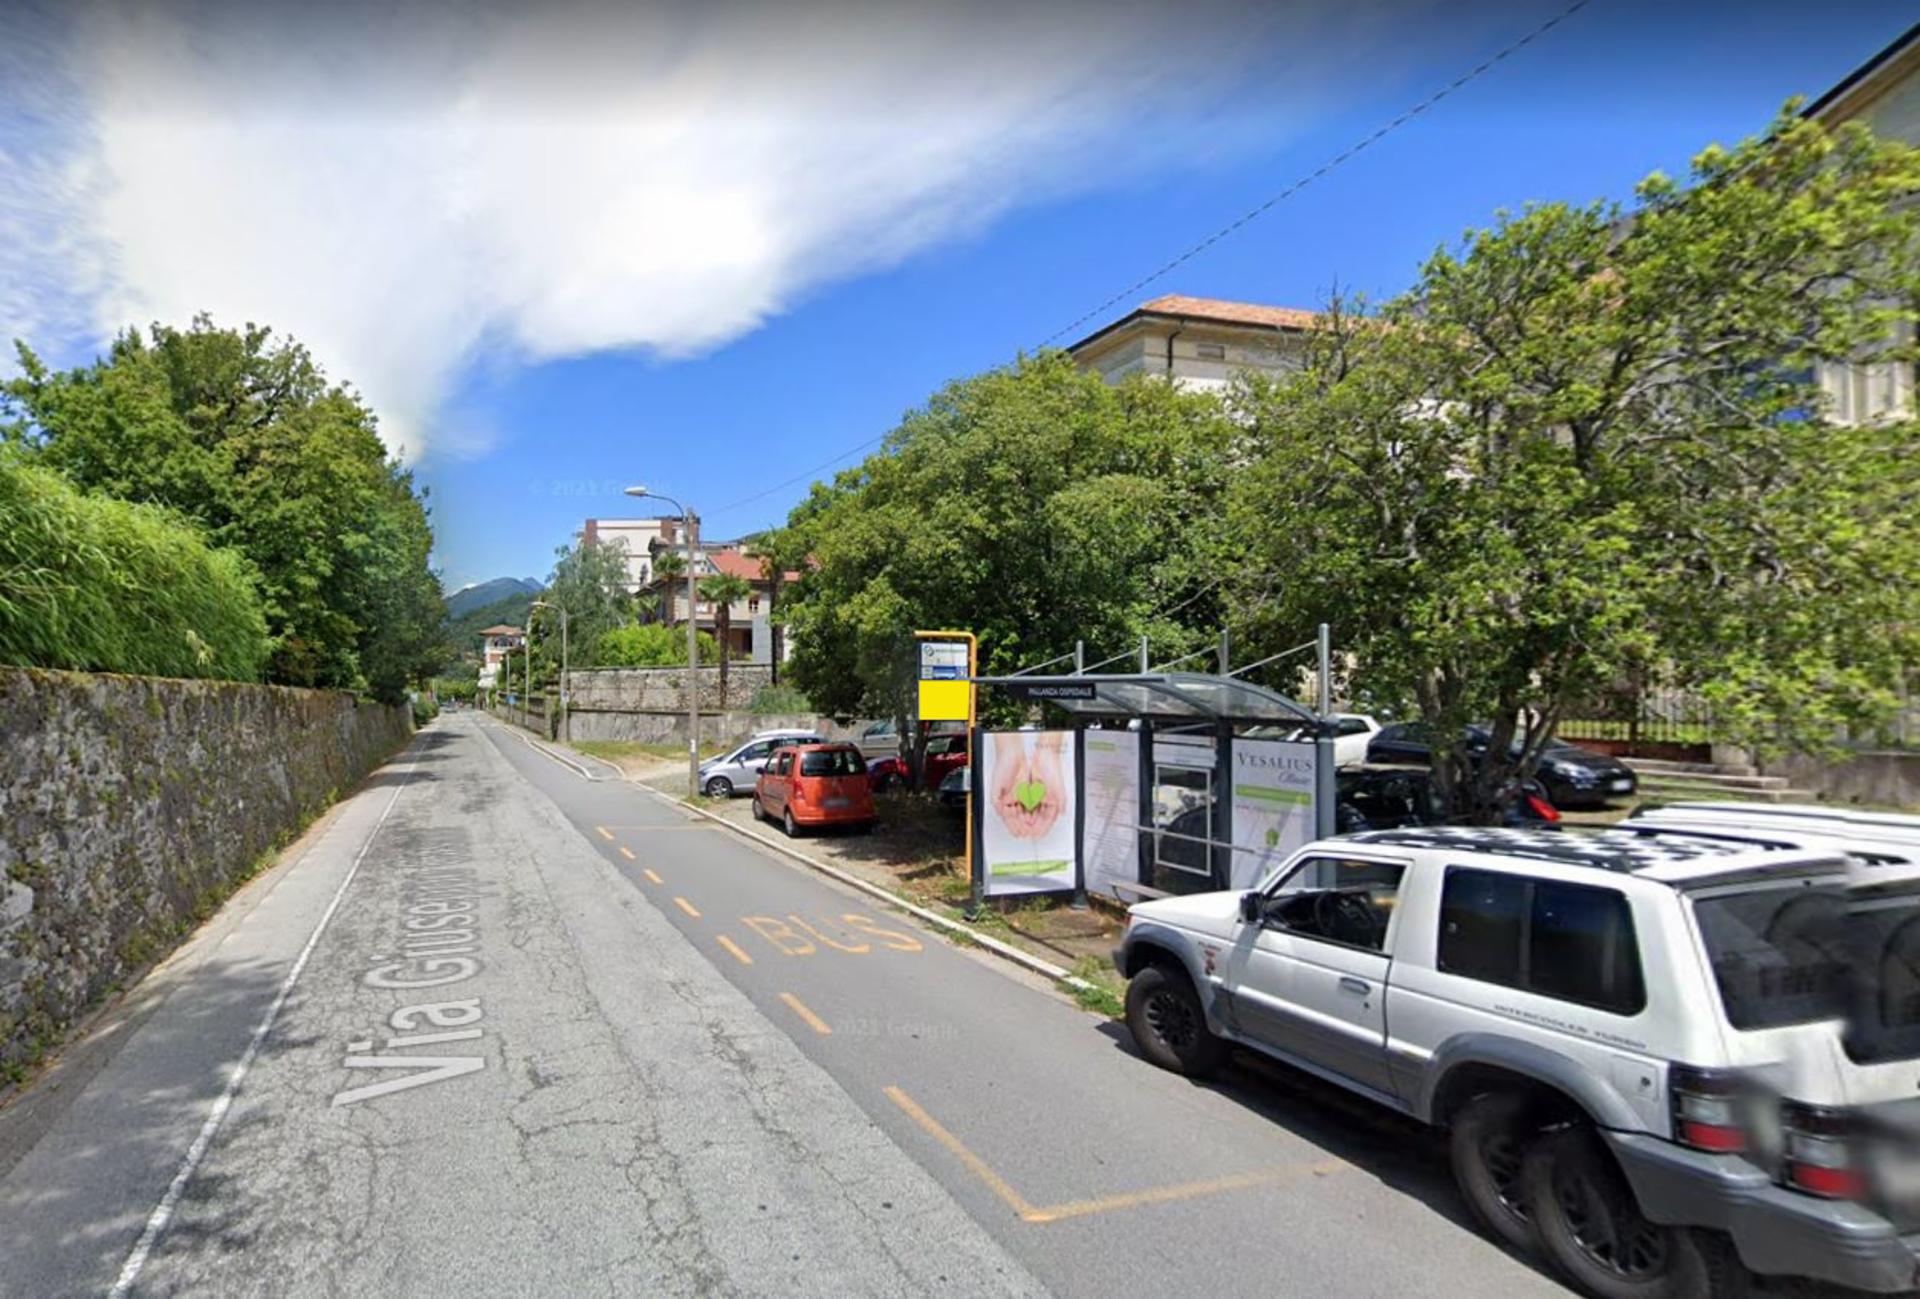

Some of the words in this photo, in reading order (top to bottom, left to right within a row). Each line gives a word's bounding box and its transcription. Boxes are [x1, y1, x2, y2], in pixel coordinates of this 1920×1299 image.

[1028, 687, 1058, 697] PALLANZA
[1059, 687, 1092, 697] OSPEDALE
[1236, 751, 1314, 770] VESALIUS
[739, 912, 925, 956] BUS
